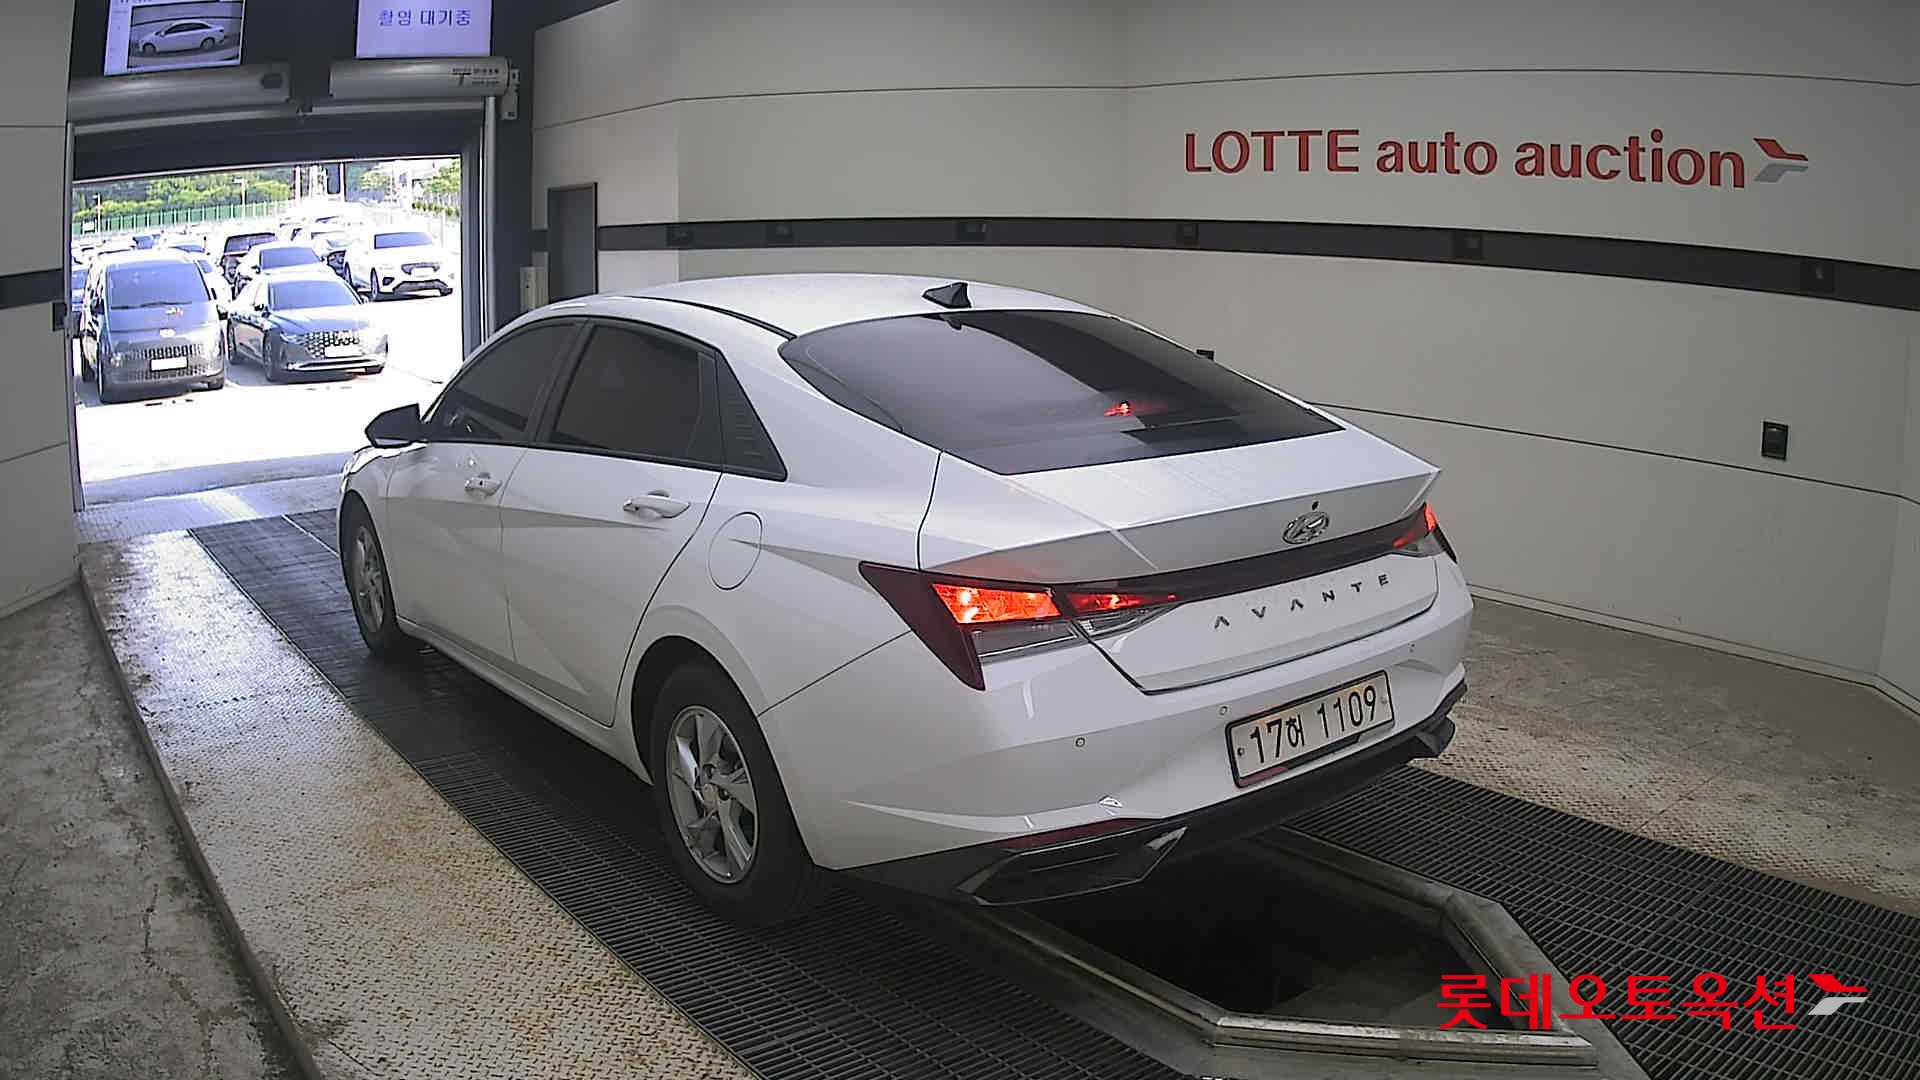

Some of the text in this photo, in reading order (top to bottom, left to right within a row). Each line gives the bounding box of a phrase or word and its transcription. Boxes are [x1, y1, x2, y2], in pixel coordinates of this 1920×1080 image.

[420, 9, 471, 26] 대기중
[1184, 128, 1746, 188] LOTTE auto auction
[1214, 573, 1389, 629] AVANTE
[1249, 685, 1377, 763] 17허 1109
